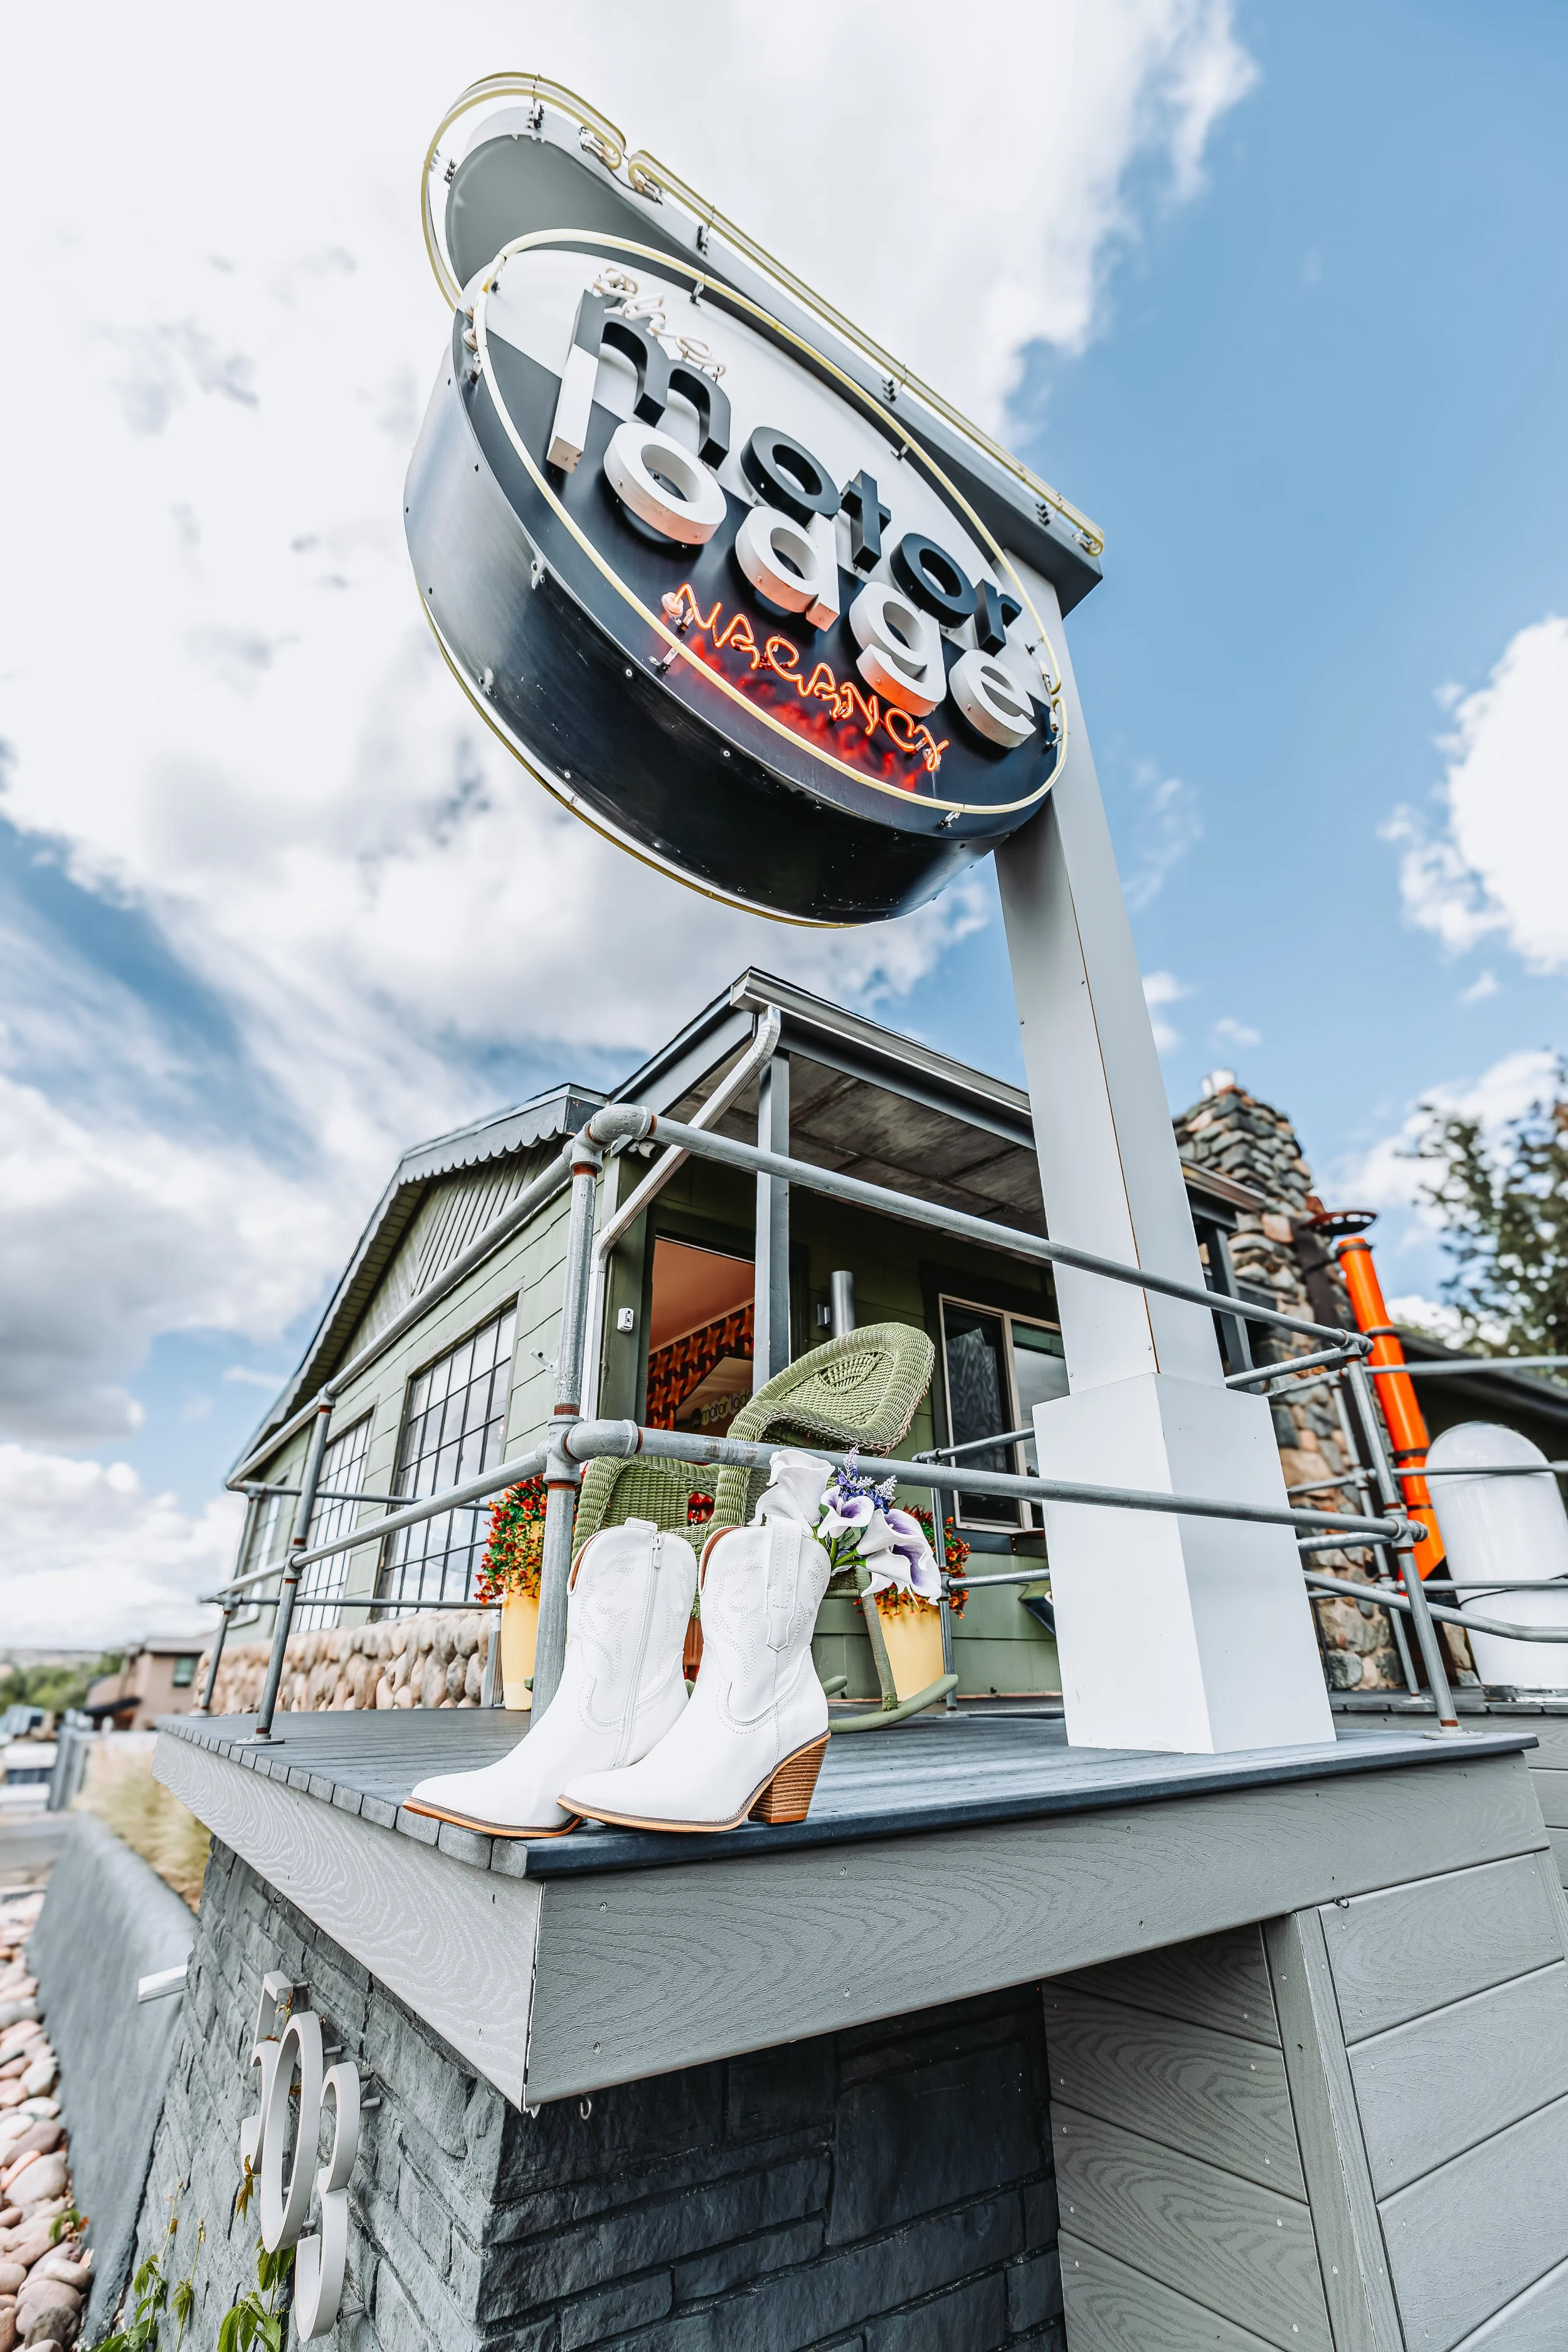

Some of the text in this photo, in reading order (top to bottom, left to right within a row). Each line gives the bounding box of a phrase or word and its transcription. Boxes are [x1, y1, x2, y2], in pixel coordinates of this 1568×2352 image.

[547, 342, 1037, 750] lodge
[568, 289, 1023, 658] motor
[240, 1969, 361, 2343] 503
